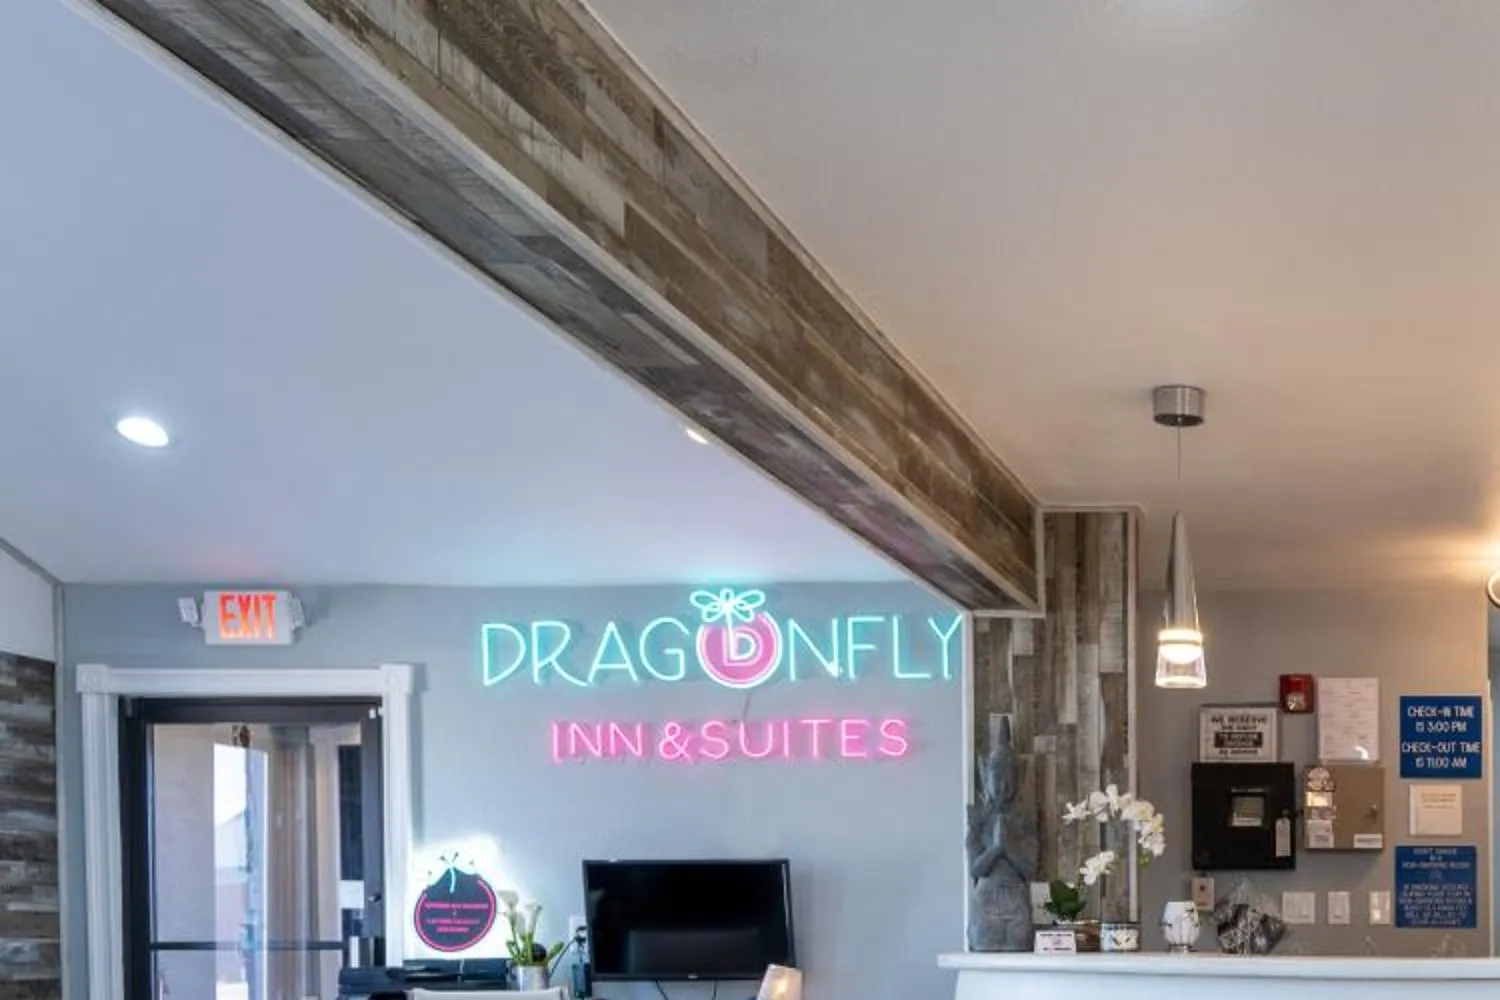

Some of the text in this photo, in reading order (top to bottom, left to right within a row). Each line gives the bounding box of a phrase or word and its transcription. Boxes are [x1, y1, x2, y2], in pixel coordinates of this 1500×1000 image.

[219, 593, 276, 641] EXIT
[481, 592, 965, 690] DRAGONFLY
[1407, 705, 1475, 717] CHECK-IN TIME
[552, 722, 643, 762] INN
[1401, 741, 1481, 753] CHECK-OUT TIME
